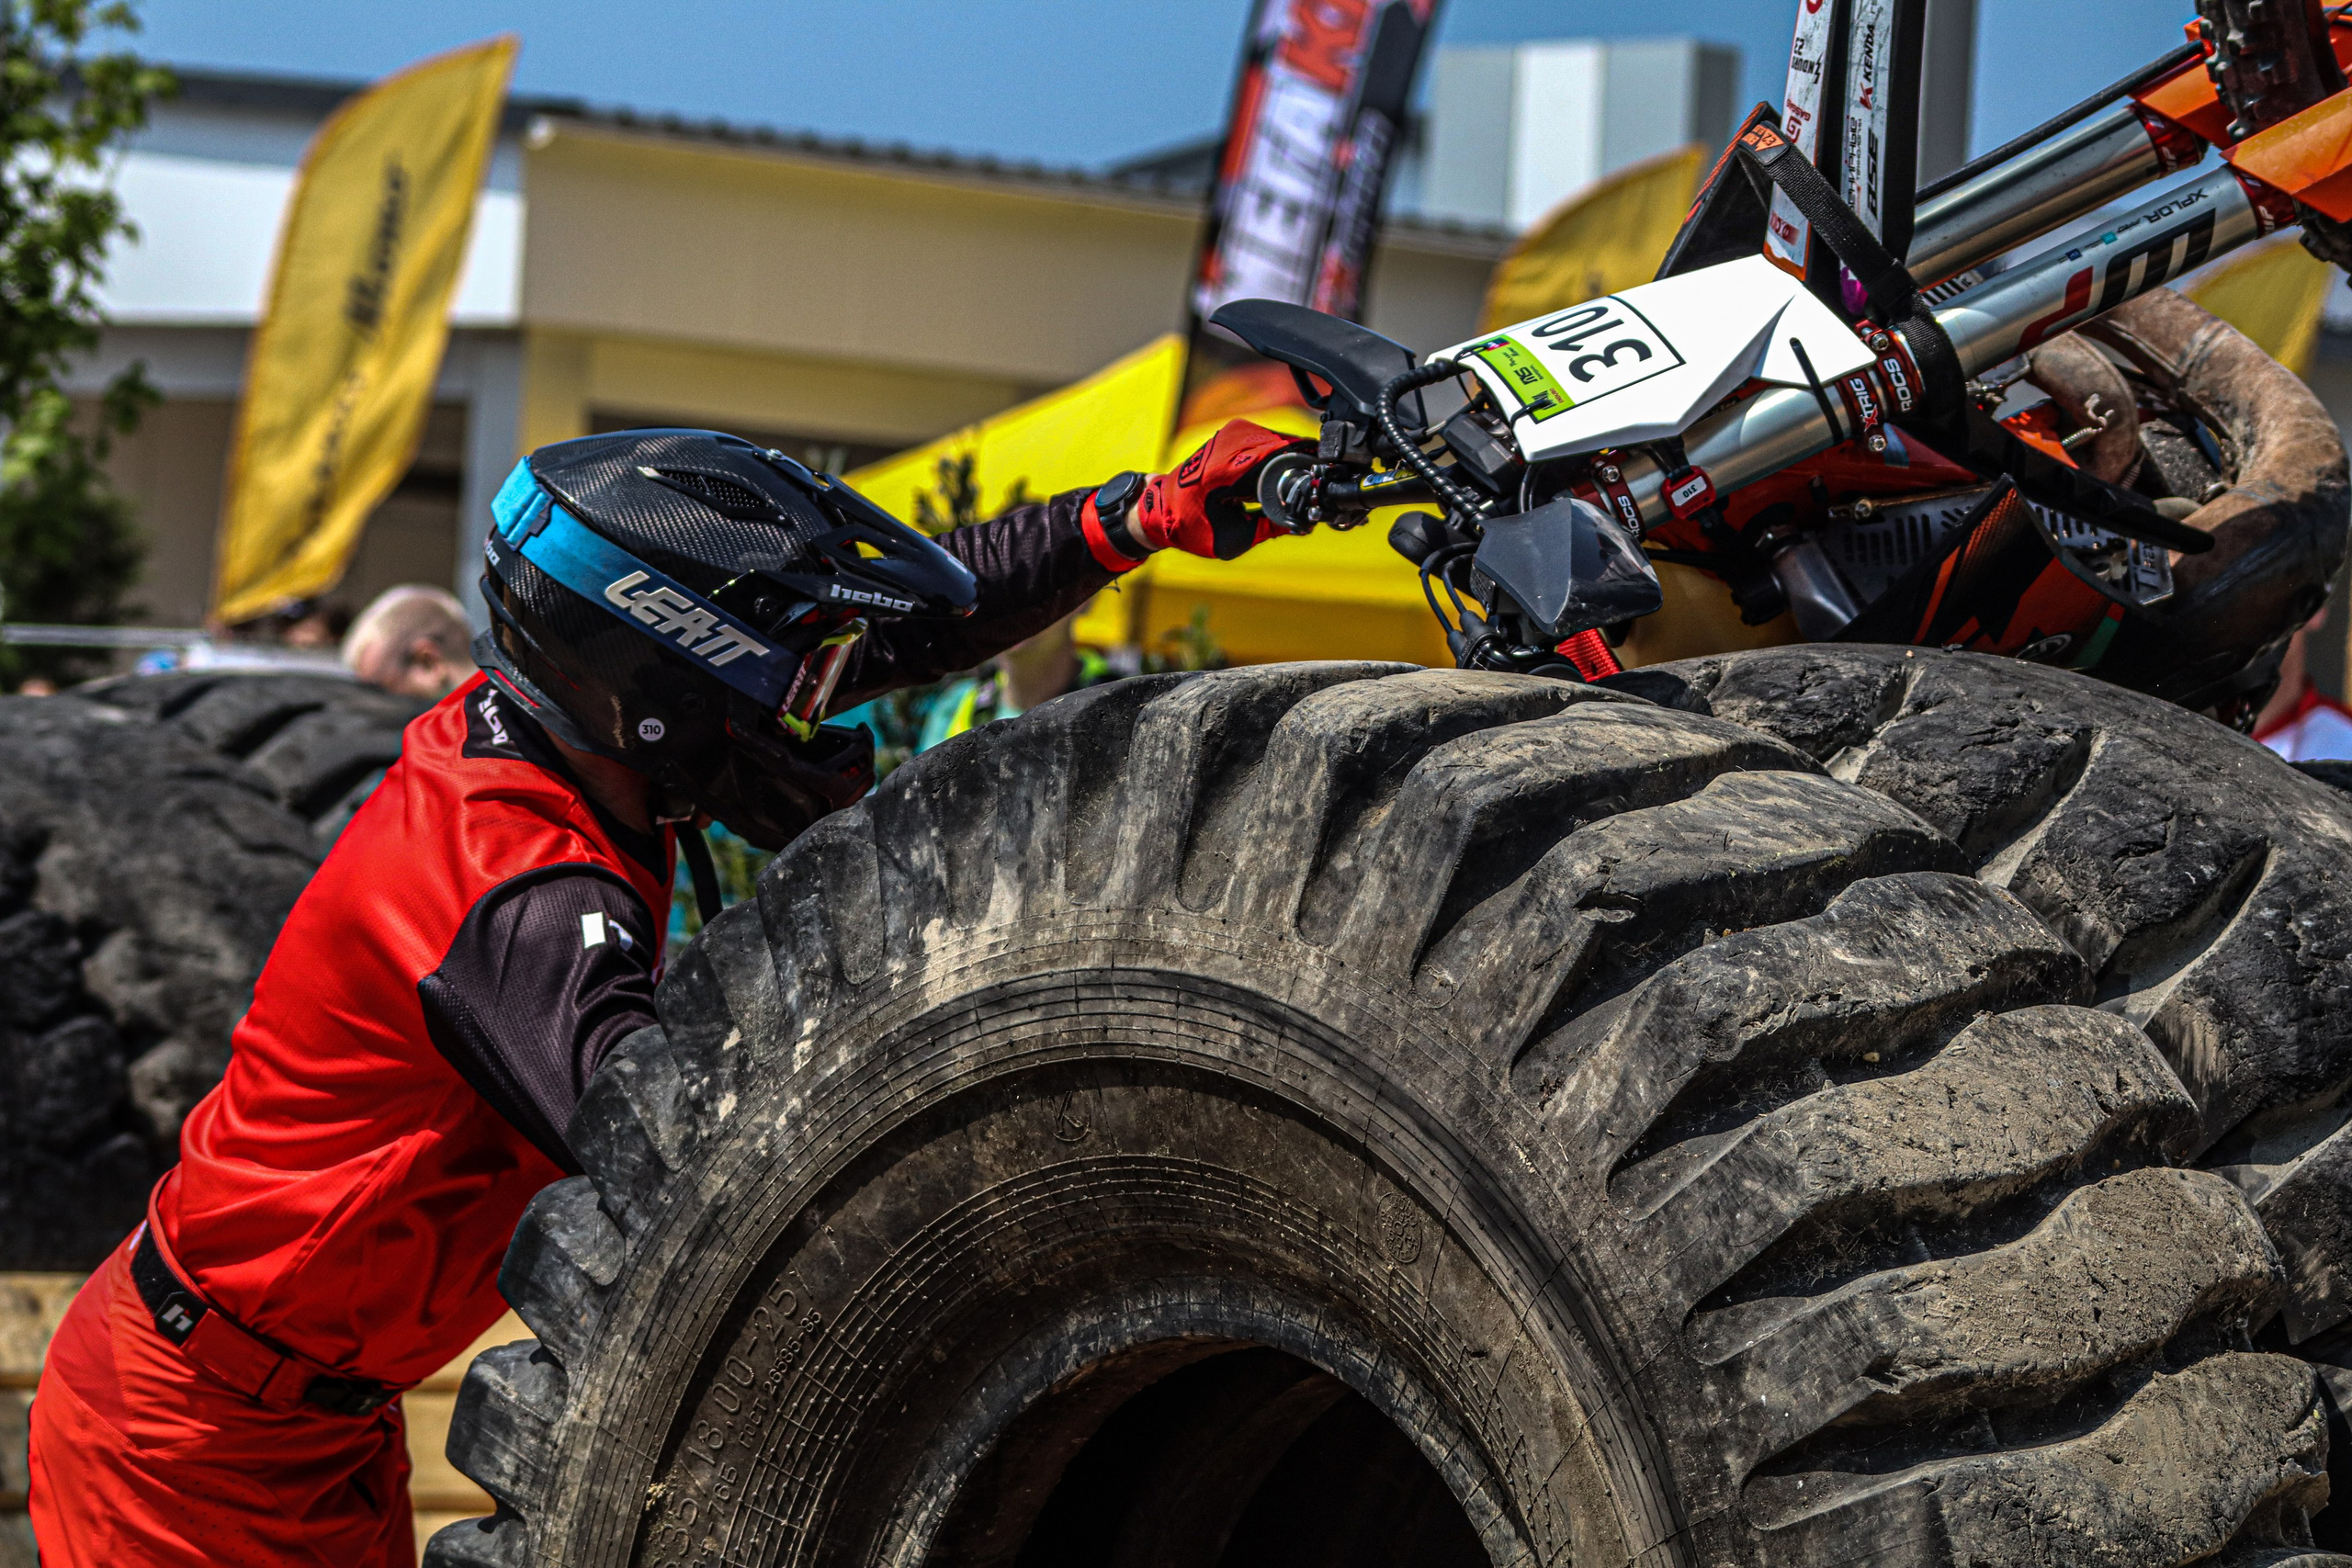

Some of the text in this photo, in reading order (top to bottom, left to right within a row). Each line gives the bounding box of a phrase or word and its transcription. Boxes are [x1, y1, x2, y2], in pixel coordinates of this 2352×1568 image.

[1862, 24, 1875, 83] KENDA
[2146, 187, 2209, 224] XPLOR
[1531, 306, 1653, 383] 310
[1883, 357, 1913, 412] ROCS
[1682, 483, 1698, 499] 310
[605, 570, 770, 667] LEATT
[830, 583, 915, 613] hebo
[642, 724, 662, 736] 310
[738, 1397, 768, 1449] ГОСТ
[763, 1306, 822, 1395] 26585-85
